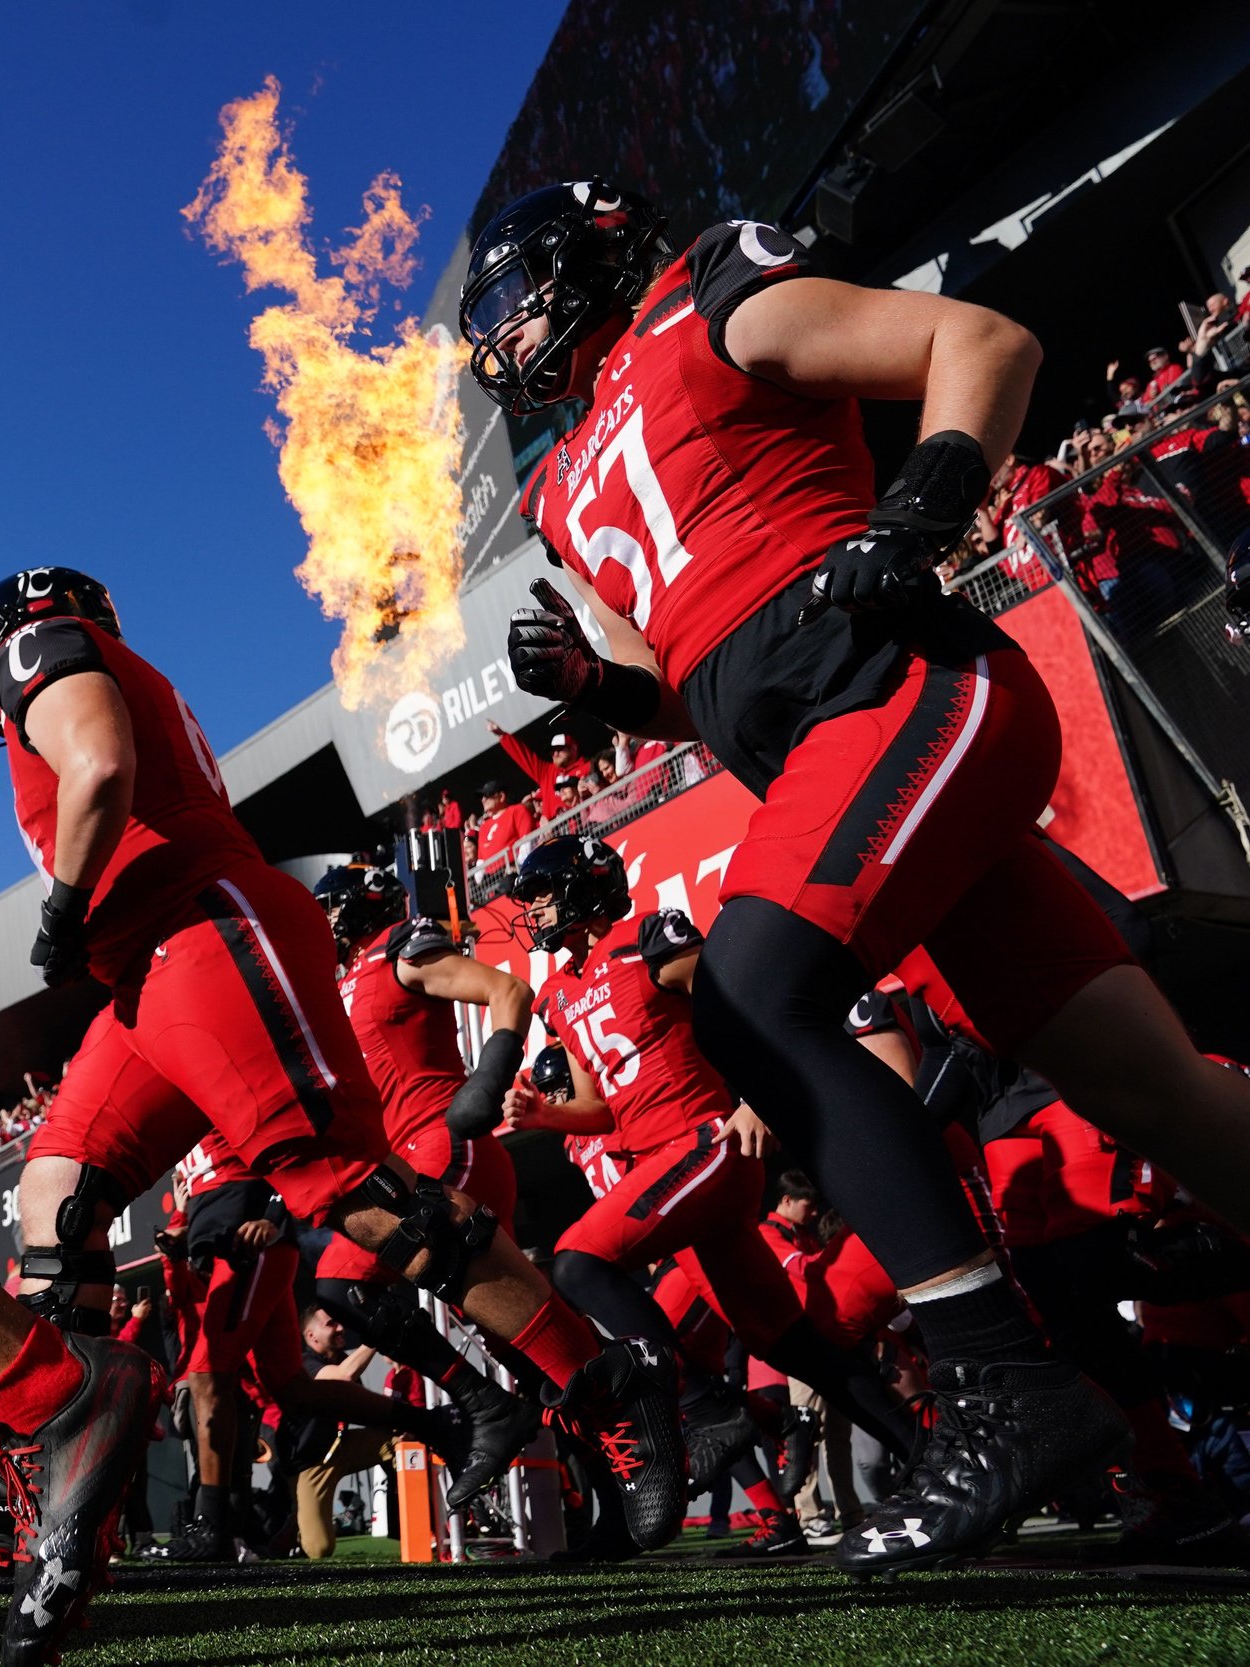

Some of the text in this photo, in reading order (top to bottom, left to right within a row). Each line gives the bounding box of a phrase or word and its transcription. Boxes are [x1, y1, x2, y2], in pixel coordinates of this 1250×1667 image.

[566, 384, 634, 502] BEARCATS
[566, 405, 694, 632] 57
[441, 657, 516, 729] RILEY
[564, 982, 612, 1025] BEARCATS
[572, 1002, 641, 1098] 15
